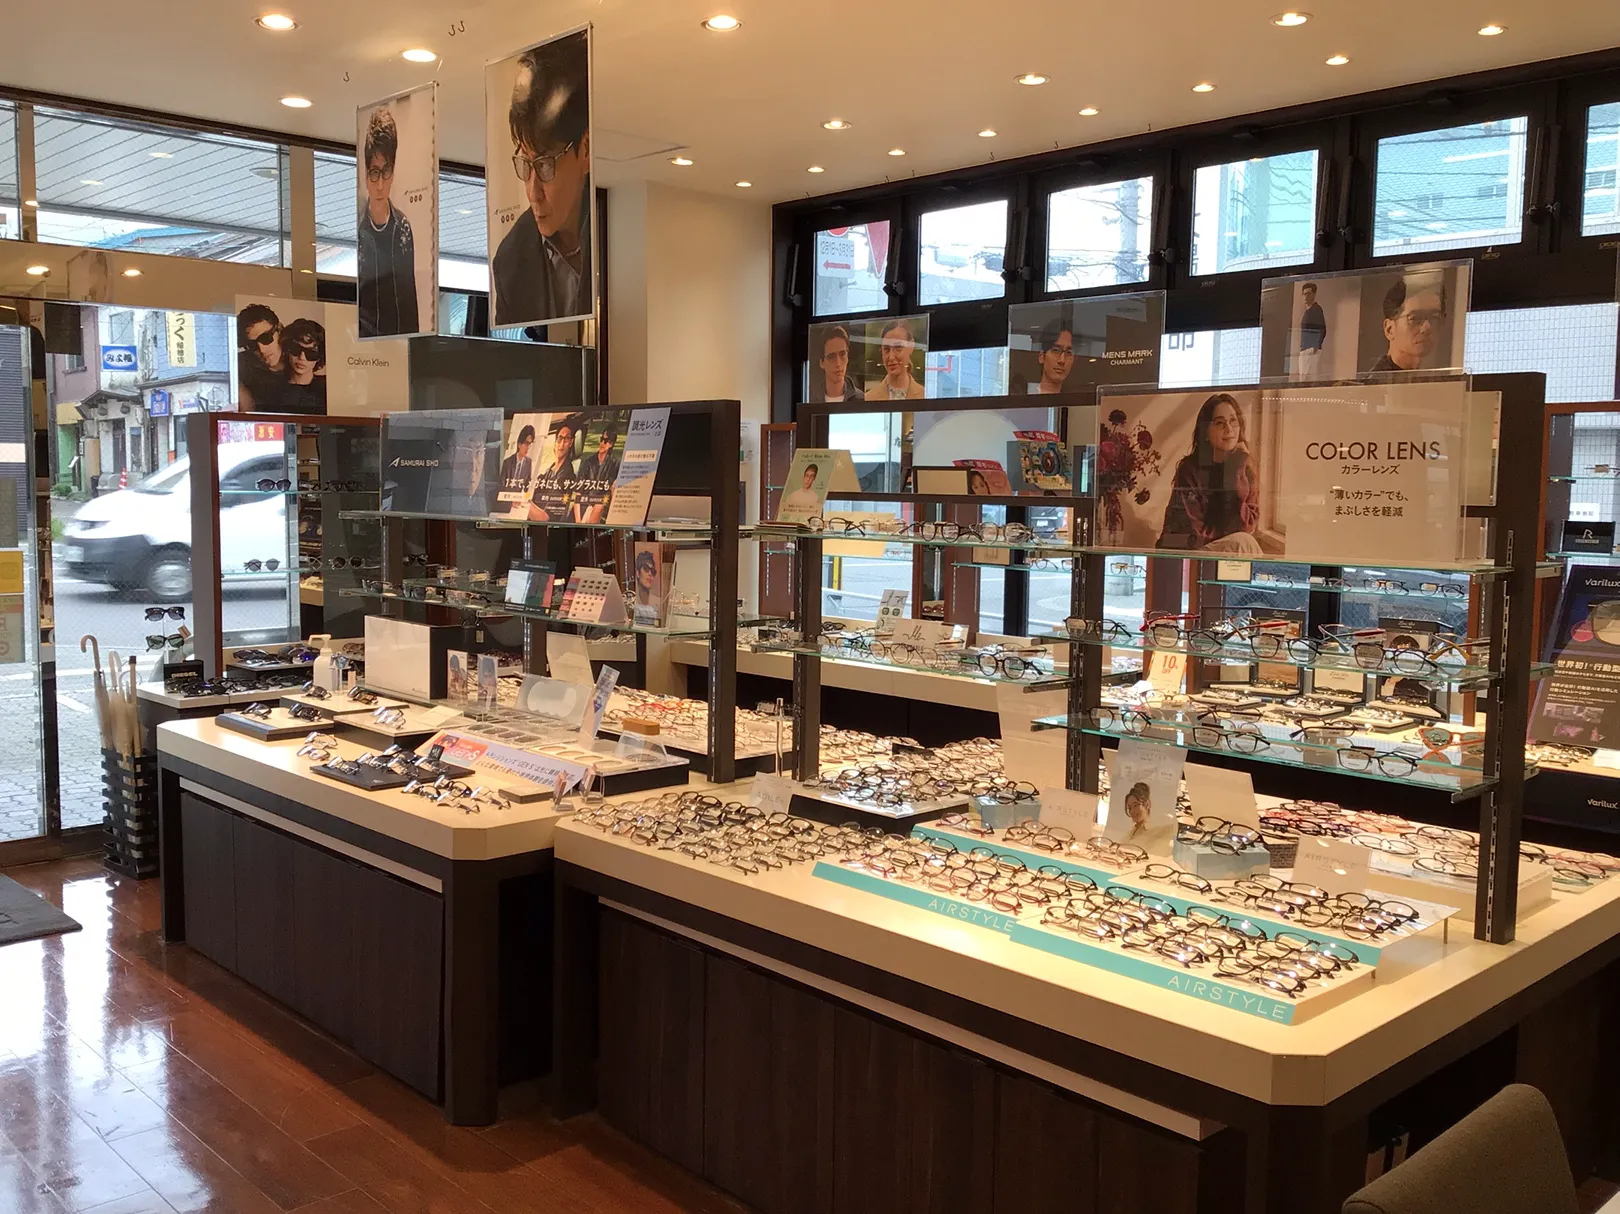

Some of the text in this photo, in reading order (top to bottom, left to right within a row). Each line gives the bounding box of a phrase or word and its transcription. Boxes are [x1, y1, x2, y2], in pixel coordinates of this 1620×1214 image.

[1102, 349, 1153, 359] MENS MARK
[347, 356, 390, 367] Calvin Klein
[1110, 358, 1144, 366] CHARMANT
[632, 418, 664, 431] 調光レンズ
[1306, 441, 1440, 460] COLOR LENS
[400, 459, 439, 467] SAMURAI SHO
[1341, 464, 1400, 475] カラーレンズ
[1335, 505, 1403, 517] まぶしさを軽減
[928, 898, 1014, 933] AIRSTYLE
[1167, 974, 1289, 1020] AIRSTYLE
